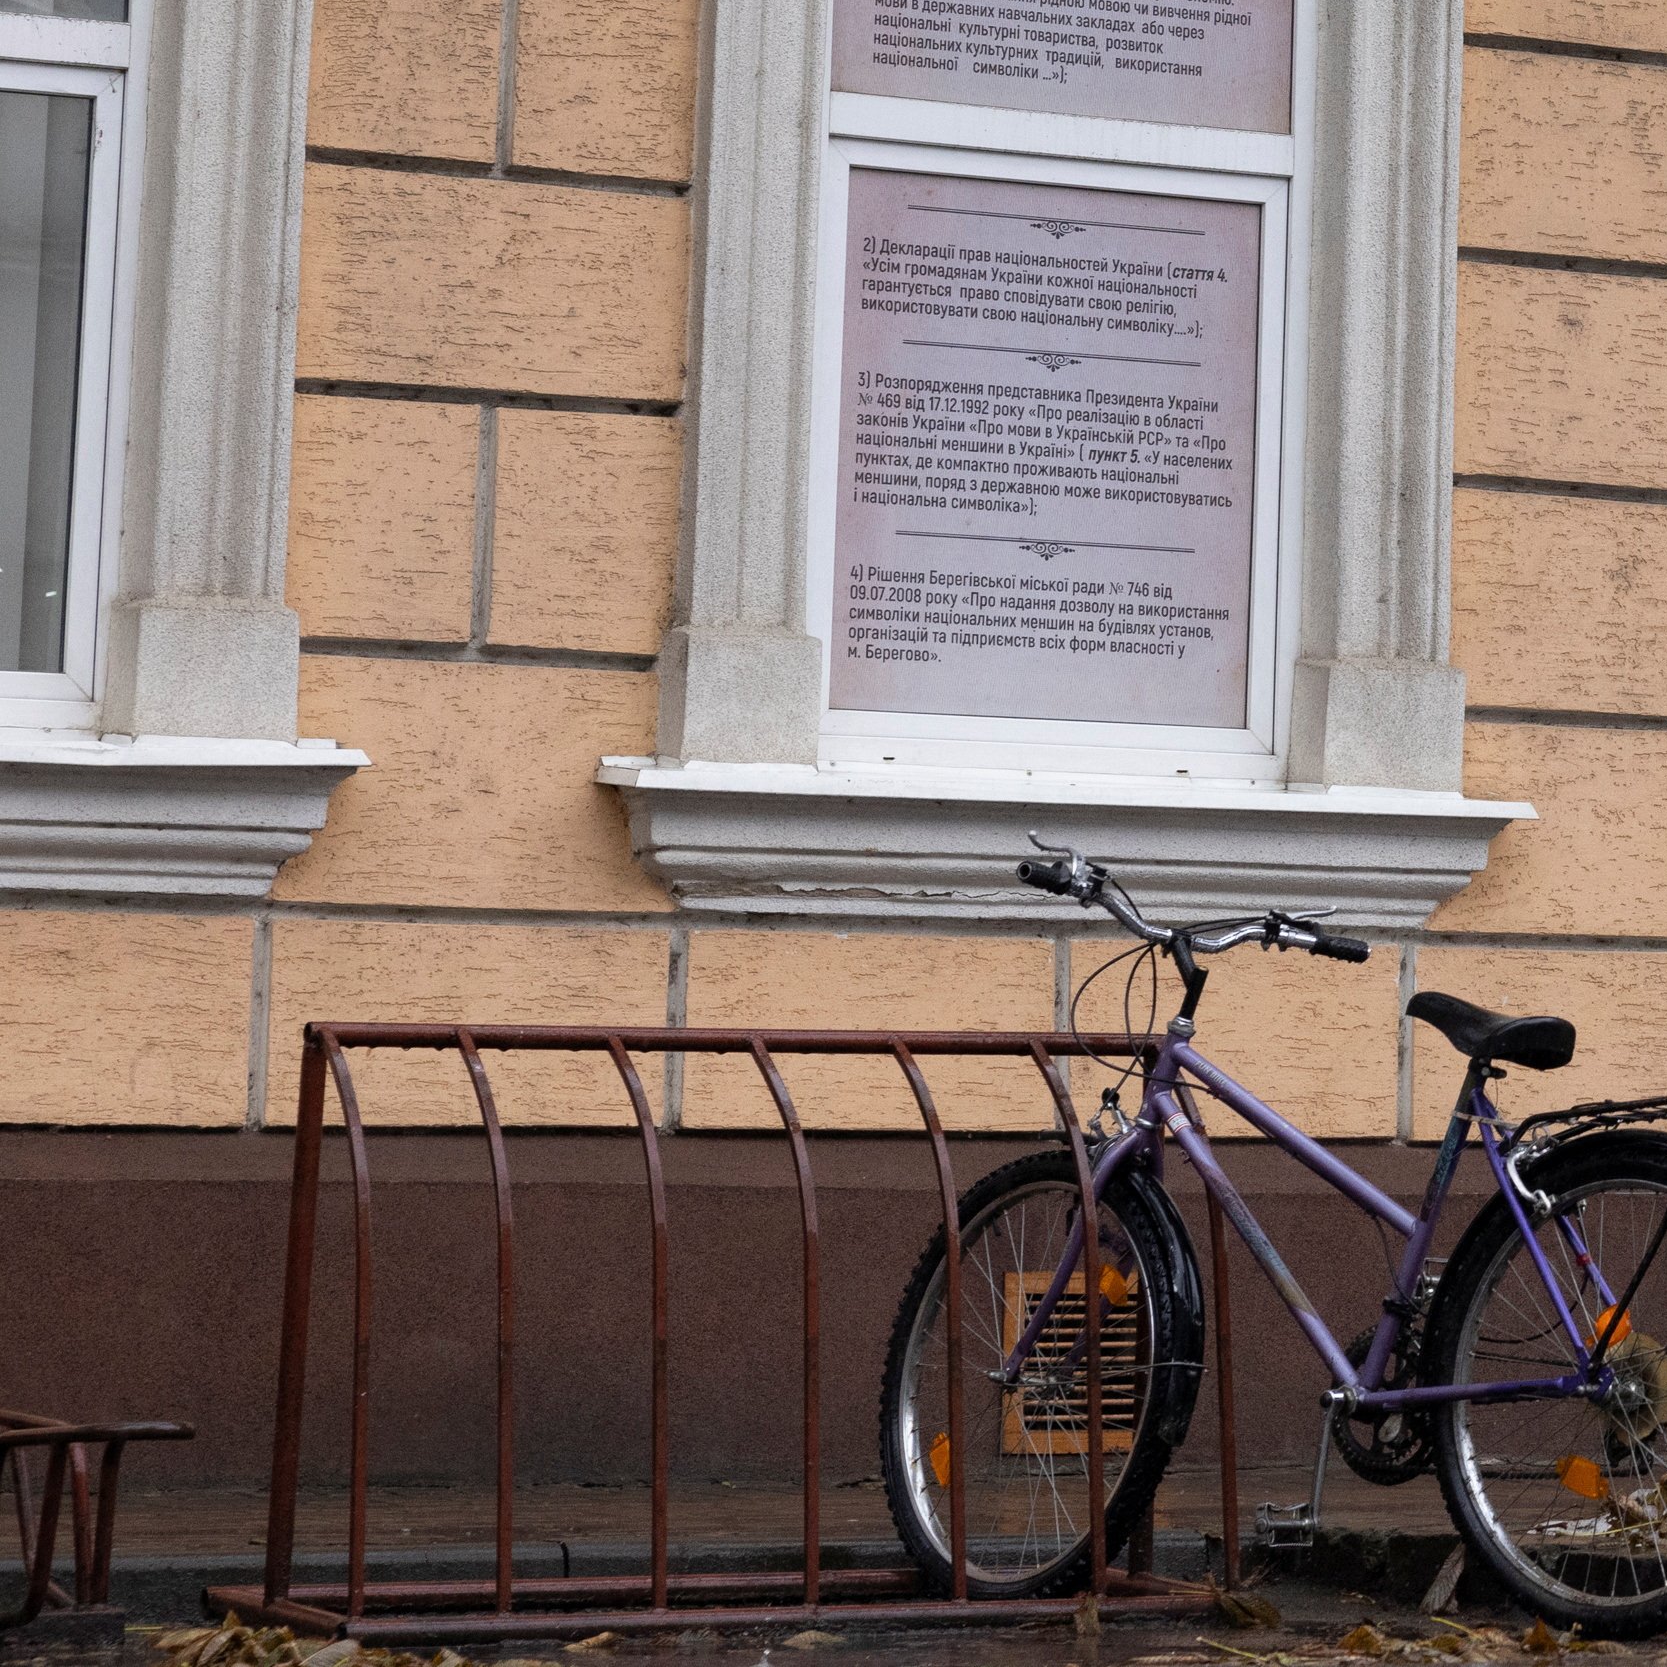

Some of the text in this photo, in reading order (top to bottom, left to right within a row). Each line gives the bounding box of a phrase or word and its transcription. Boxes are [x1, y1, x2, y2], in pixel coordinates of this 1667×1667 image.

[863, 257, 1197, 298] «Усім громадянам України кожної національності
[864, 236, 1227, 282] 2) Декларації прав національностей України (стаття 4.
[858, 371, 1218, 413] 3) Розпорядження представника Президента України
[877, 393, 900, 408] 469
[905, 395, 925, 412] від
[929, 397, 989, 414] 17.12.1992
[994, 404, 1024, 420] року
[1029, 404, 1062, 422] «Про
[1067, 408, 1139, 426] реалізацію
[1144, 416, 1151, 426] в
[1155, 414, 1203, 430] області
[850, 564, 863, 582] 4)
[868, 567, 924, 584] Рішення
[930, 570, 1016, 589] Берегівської
[1020, 576, 1069, 592] міської
[1073, 582, 1104, 596] ради
[1128, 582, 1149, 597] 746
[1154, 583, 1172, 600] від
[848, 644, 941, 662] м. Берегово».
